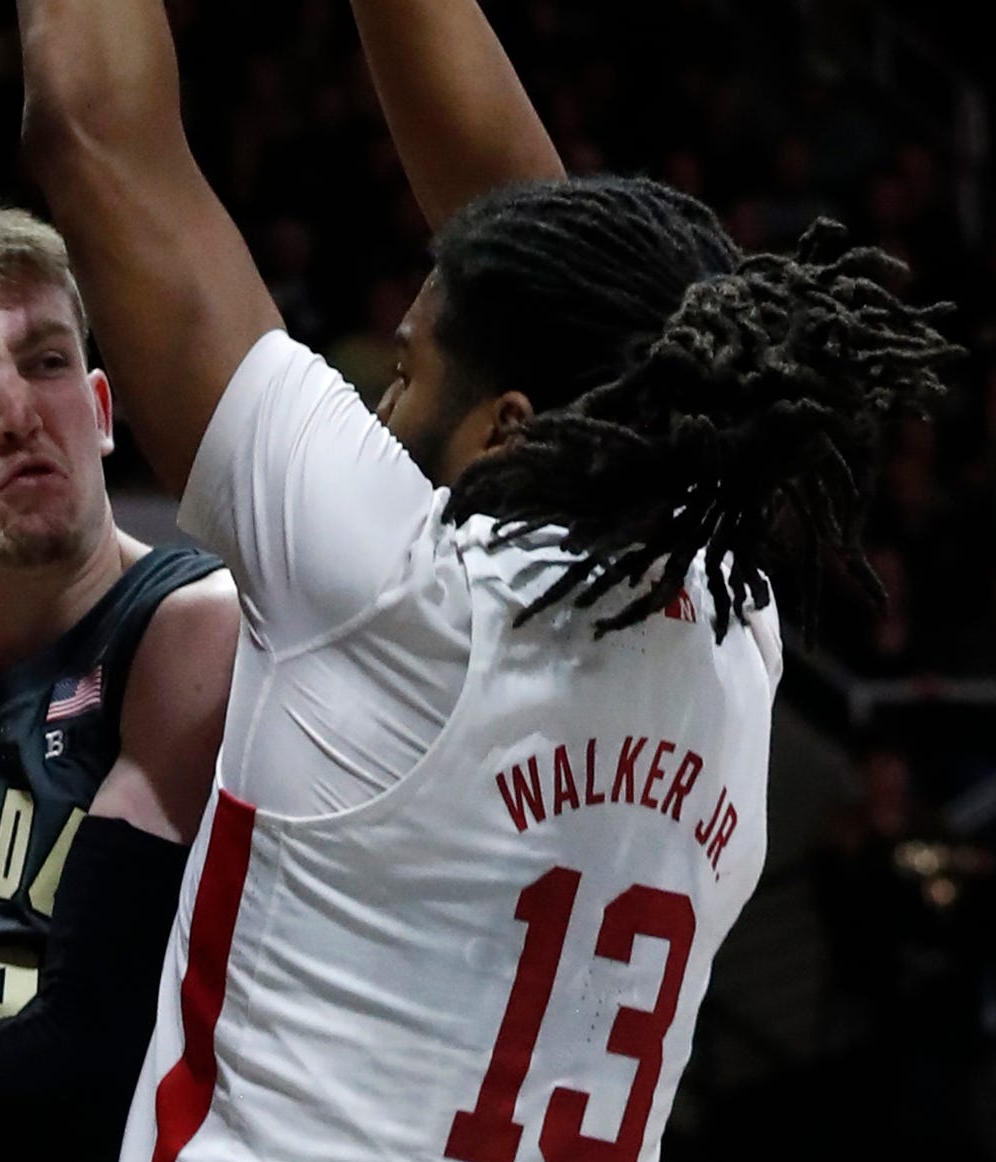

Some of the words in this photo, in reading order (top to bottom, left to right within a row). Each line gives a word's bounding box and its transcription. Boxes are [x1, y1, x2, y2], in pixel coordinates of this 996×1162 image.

[45, 729, 65, 760] B
[495, 735, 704, 834] WALKER
[695, 786, 738, 883] JR.
